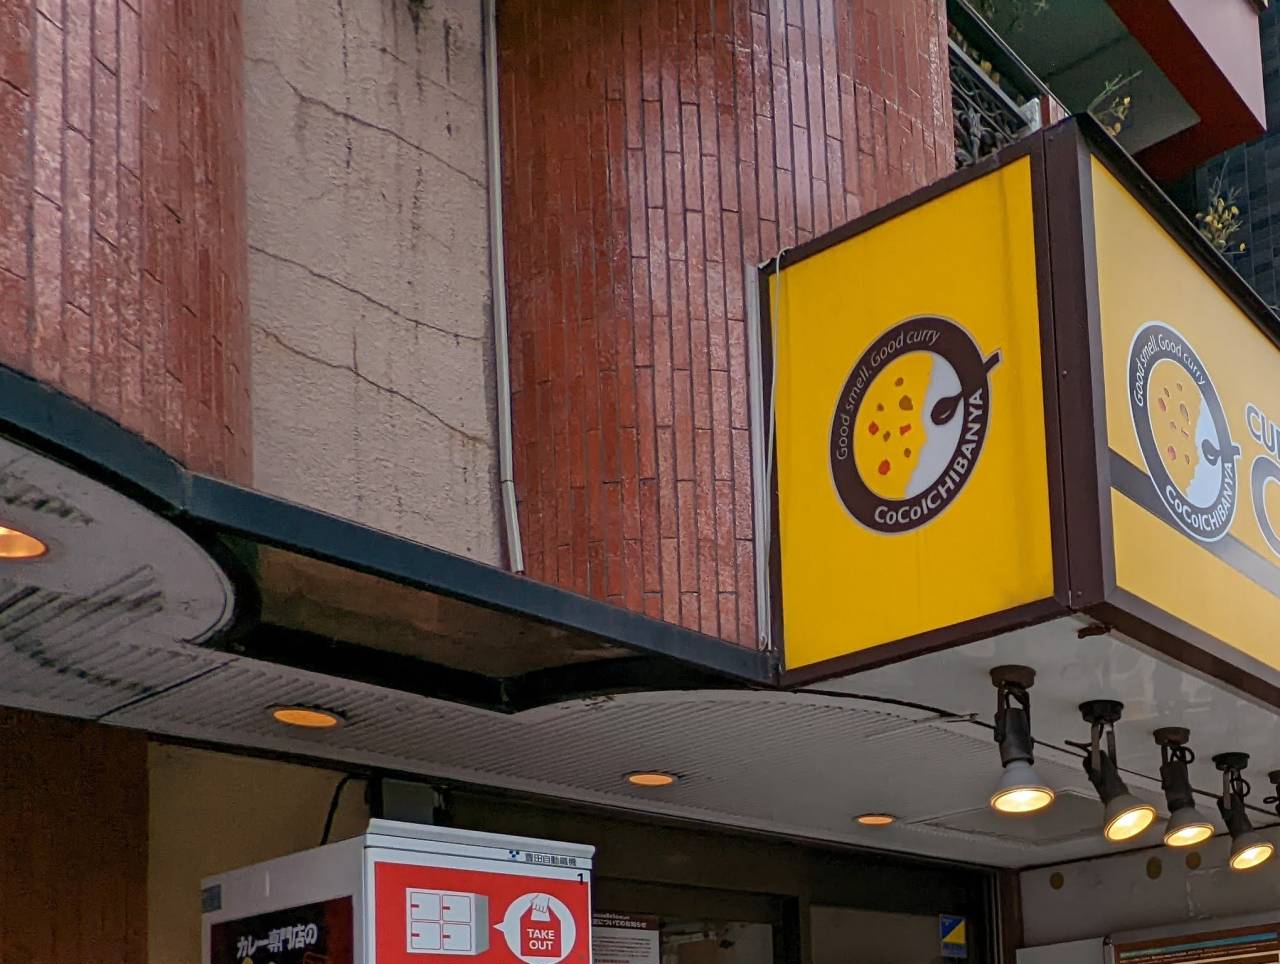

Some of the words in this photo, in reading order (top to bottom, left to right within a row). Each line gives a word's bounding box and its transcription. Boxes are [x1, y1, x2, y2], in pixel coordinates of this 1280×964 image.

[1133, 357, 1145, 407] Good
[1158, 334, 1182, 358] Good
[1183, 353, 1206, 386] curry
[837, 415, 850, 460] Good
[870, 331, 904, 368] Good
[906, 329, 941, 346] curry
[237, 923, 318, 958] カレー専門店の
[527, 929, 555, 939] TAKE
[529, 940, 553, 950] OUT
